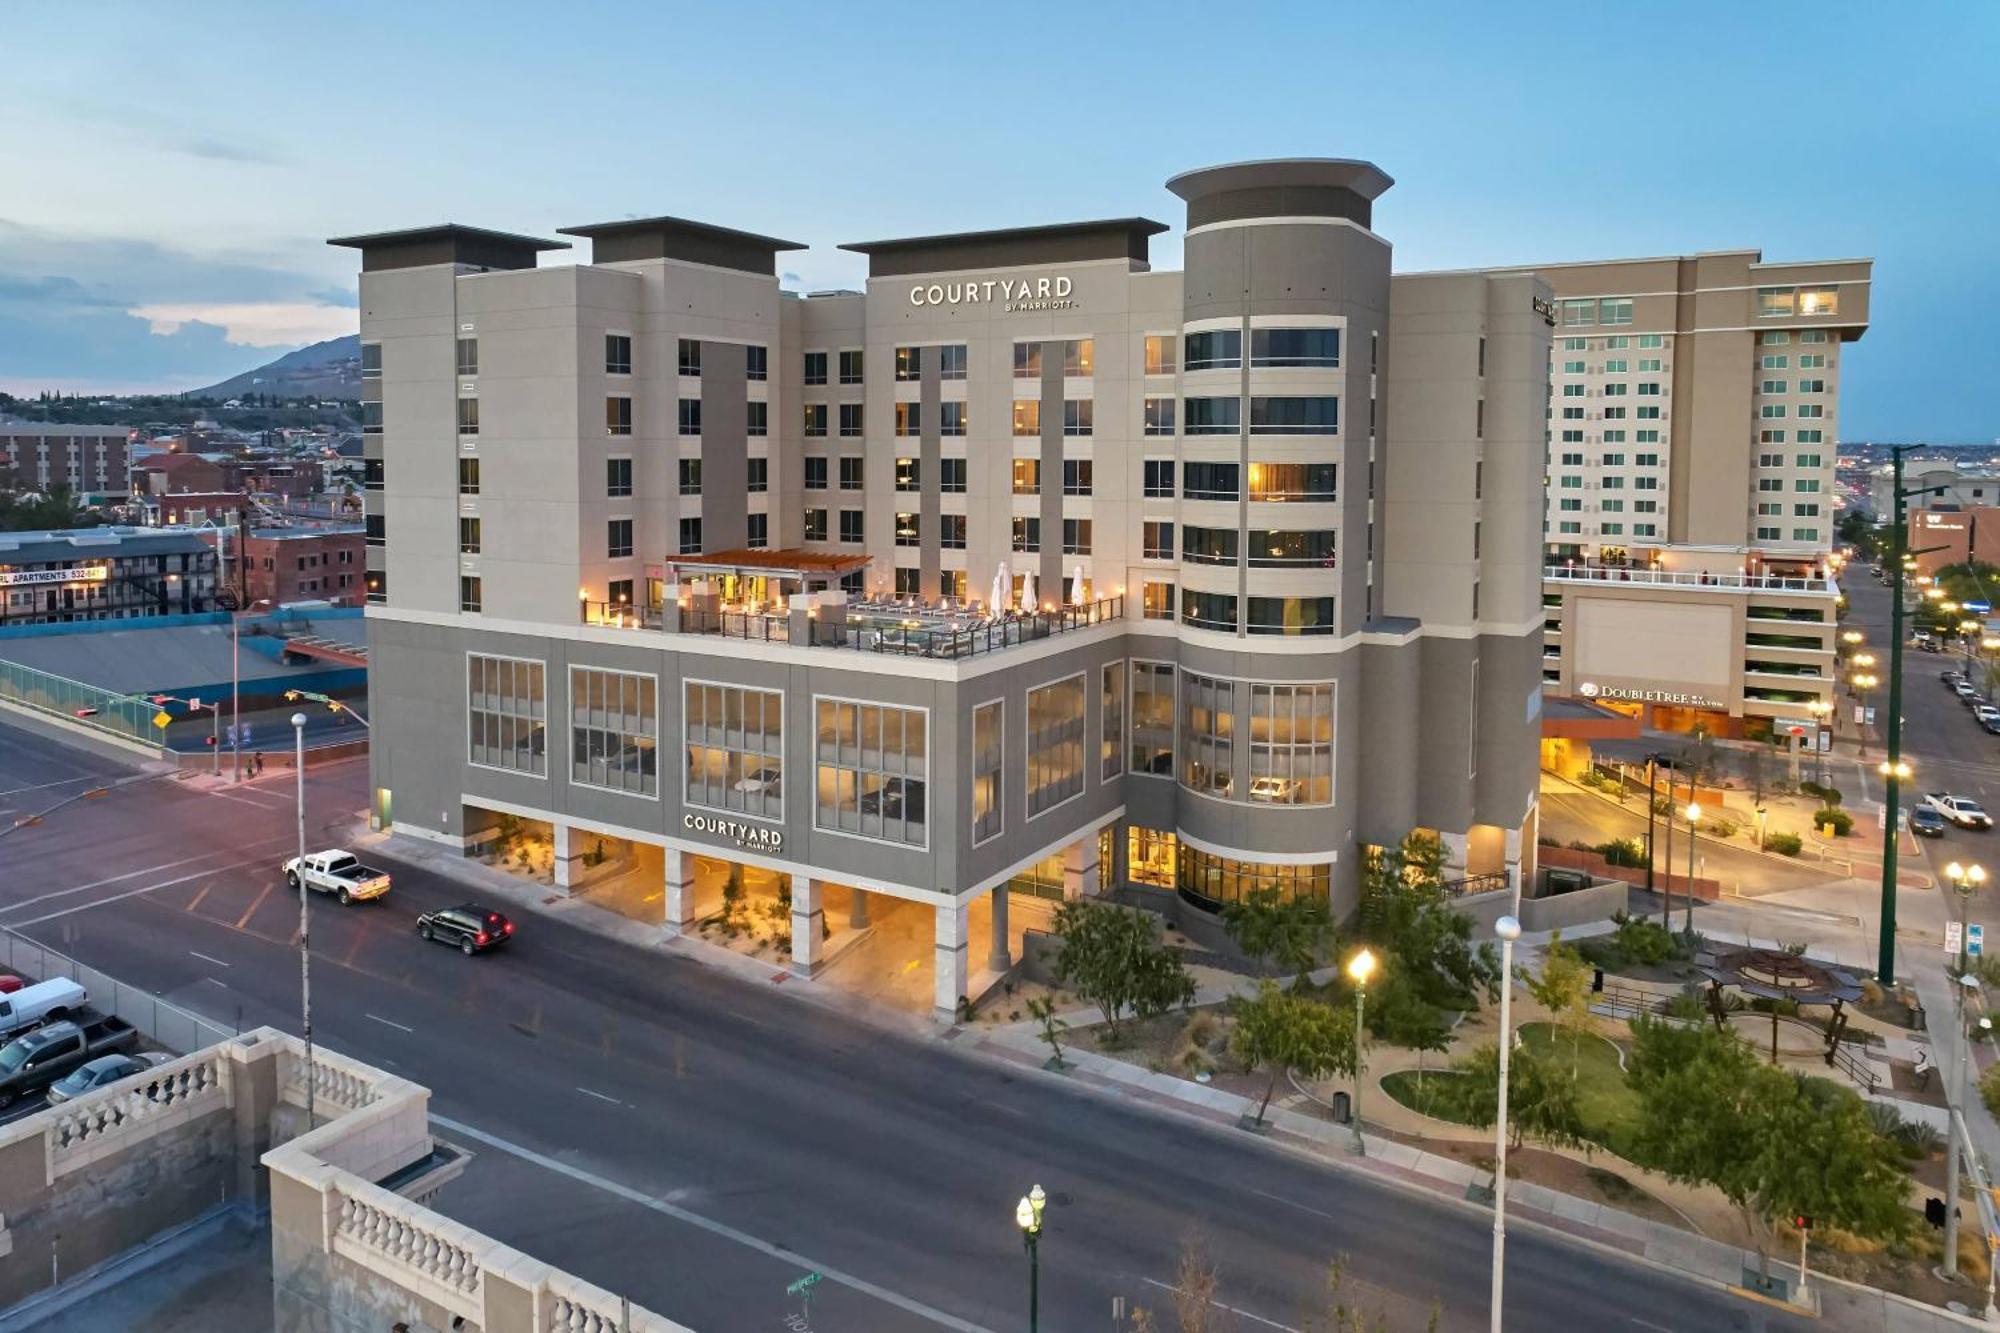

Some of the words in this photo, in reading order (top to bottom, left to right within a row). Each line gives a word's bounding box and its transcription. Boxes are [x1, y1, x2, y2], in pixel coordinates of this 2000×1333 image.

[910, 277, 1072, 306] COURTYARD
[1005, 303, 1018, 312] BY
[1020, 300, 1072, 311] MARRIOTT
[13, 571, 66, 583] APARTMENTS
[684, 814, 781, 846] COURTYARD
[746, 841, 781, 853] MARRIOTT
